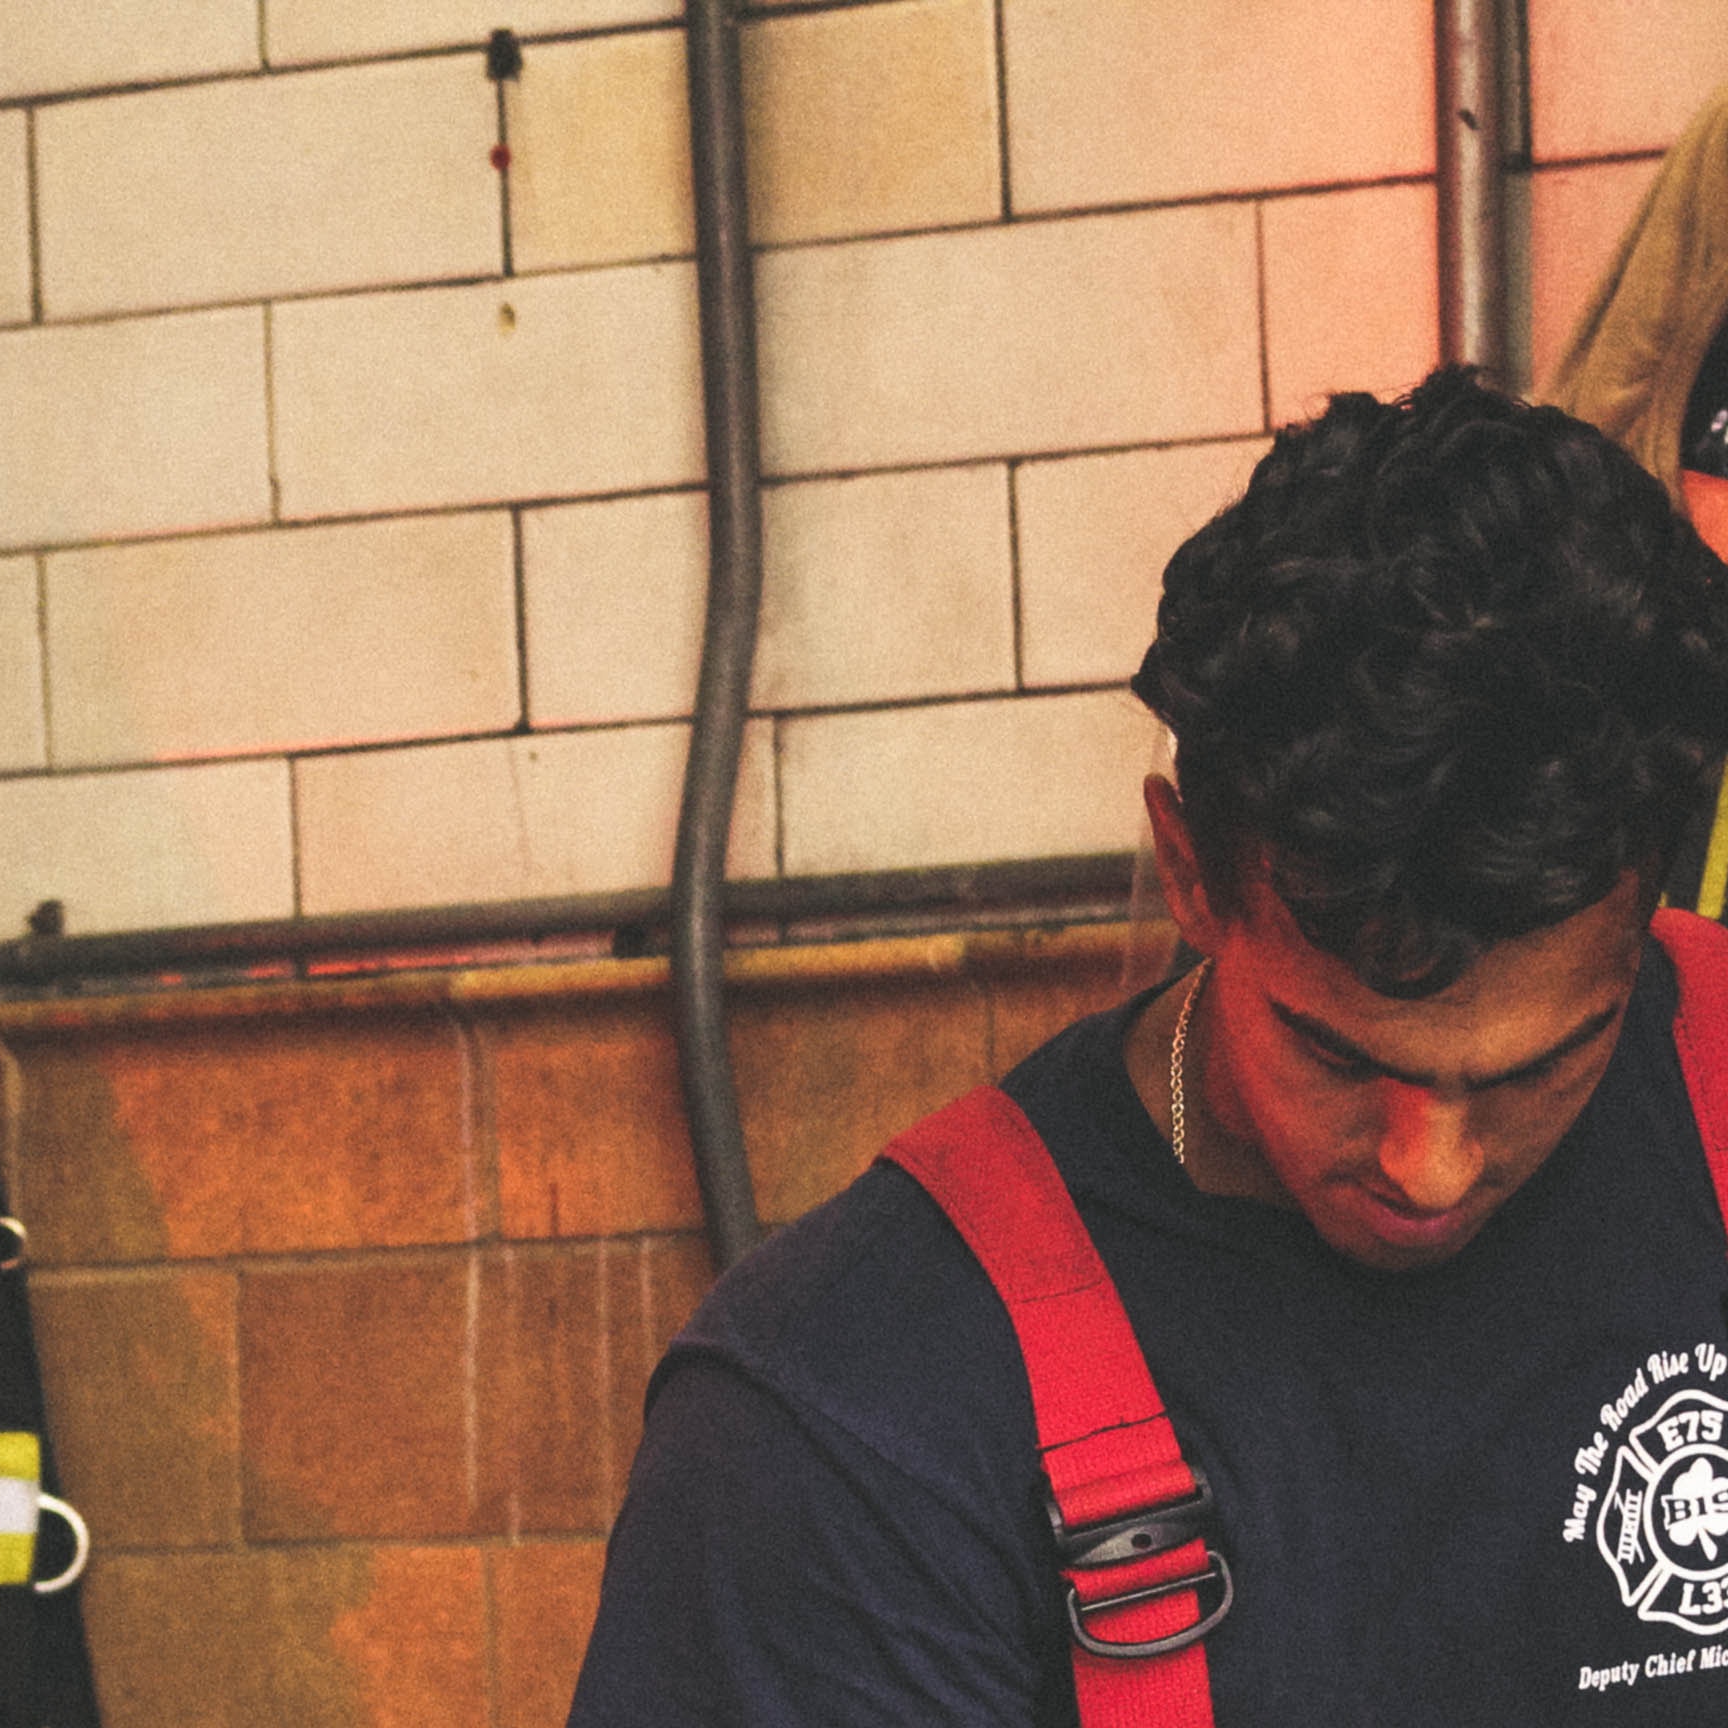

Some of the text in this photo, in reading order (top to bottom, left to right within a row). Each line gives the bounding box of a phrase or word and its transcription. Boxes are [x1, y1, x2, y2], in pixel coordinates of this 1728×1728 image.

[1562, 1342, 1728, 1543] May The Road Rise Up
[1656, 1409, 1724, 1452] E75
[1578, 1661, 1640, 1692] Deputy
[1645, 1648, 1697, 1678] Chief
